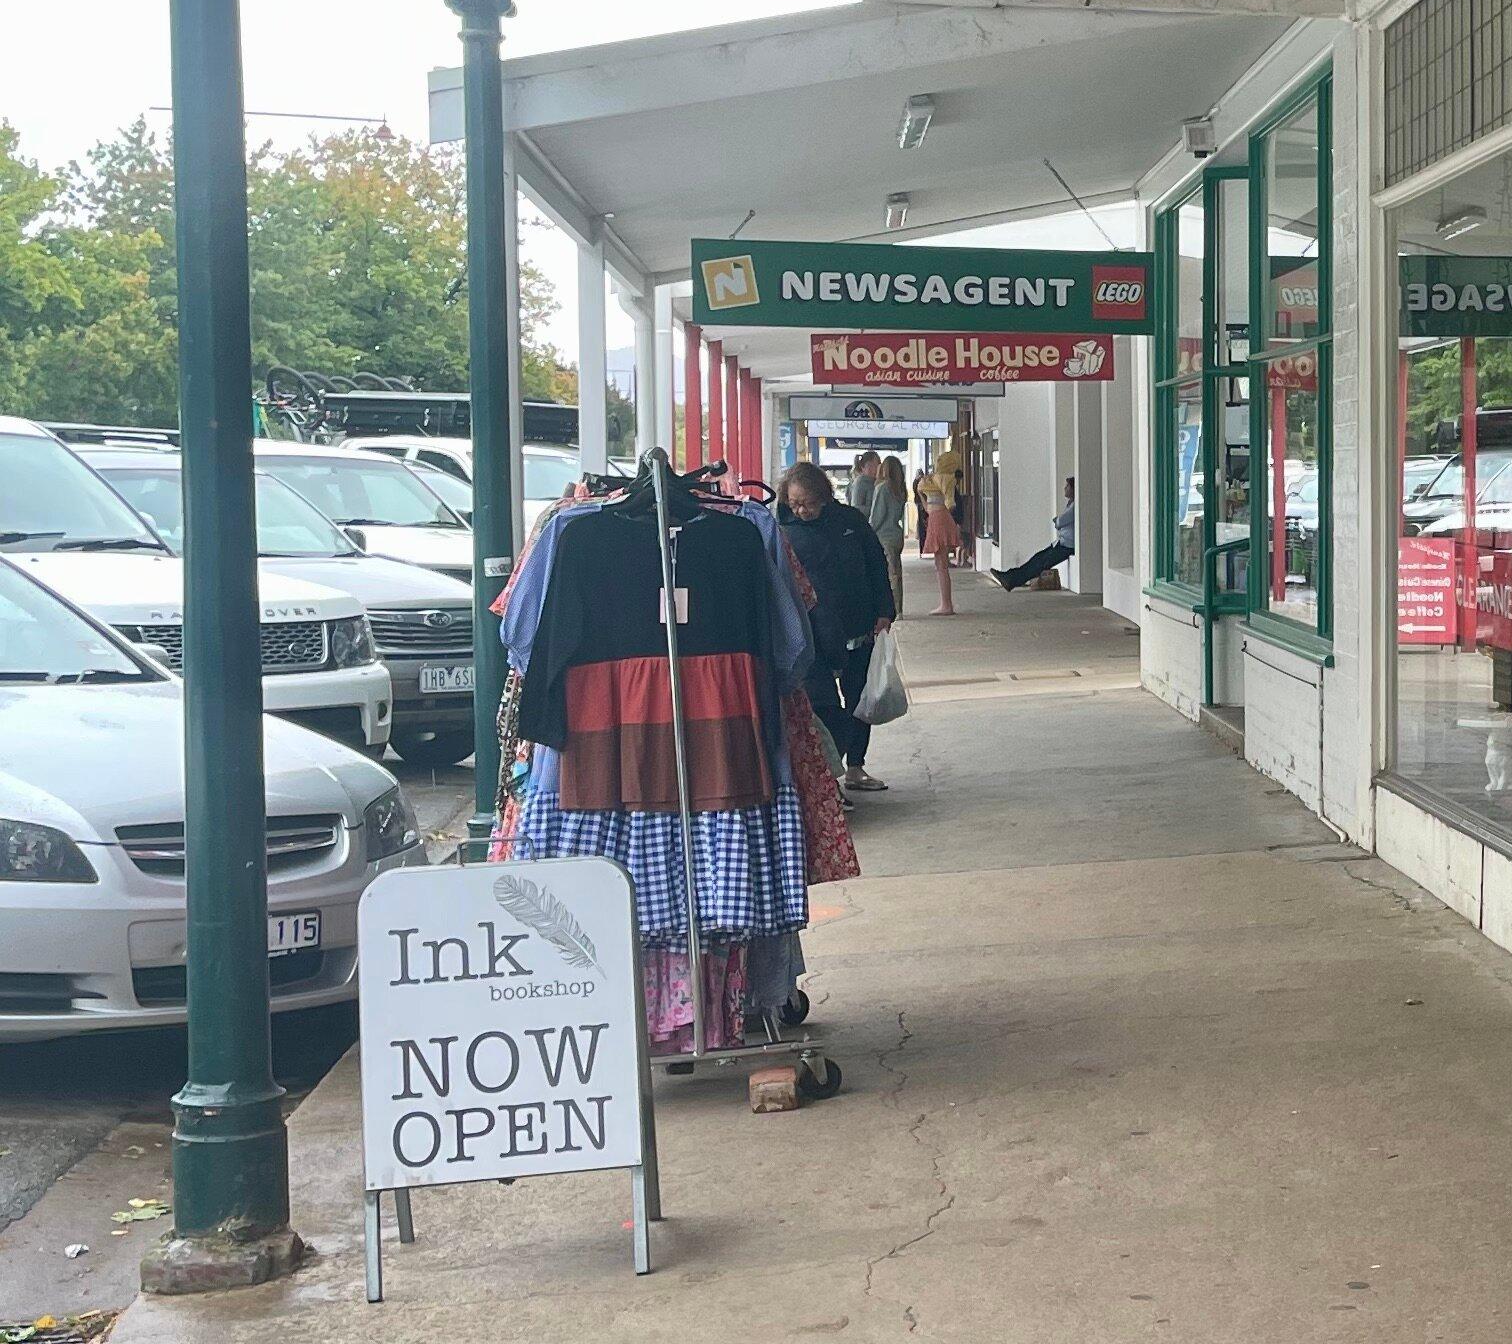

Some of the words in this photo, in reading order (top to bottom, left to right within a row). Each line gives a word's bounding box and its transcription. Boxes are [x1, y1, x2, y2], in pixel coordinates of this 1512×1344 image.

[781, 270, 1075, 307] NEWSAGENT
[1095, 281, 1144, 304] LEGO
[823, 338, 949, 370] Noodle
[955, 337, 1060, 368] House
[865, 370, 901, 382] asian
[906, 370, 950, 381] cuisine
[979, 366, 1020, 381] coffee
[264, 607, 317, 618] OVER
[388, 921, 534, 986] Ink
[488, 978, 596, 1002] bookshop
[389, 1022, 610, 1101] NOW
[392, 1095, 613, 1168] OPEN
